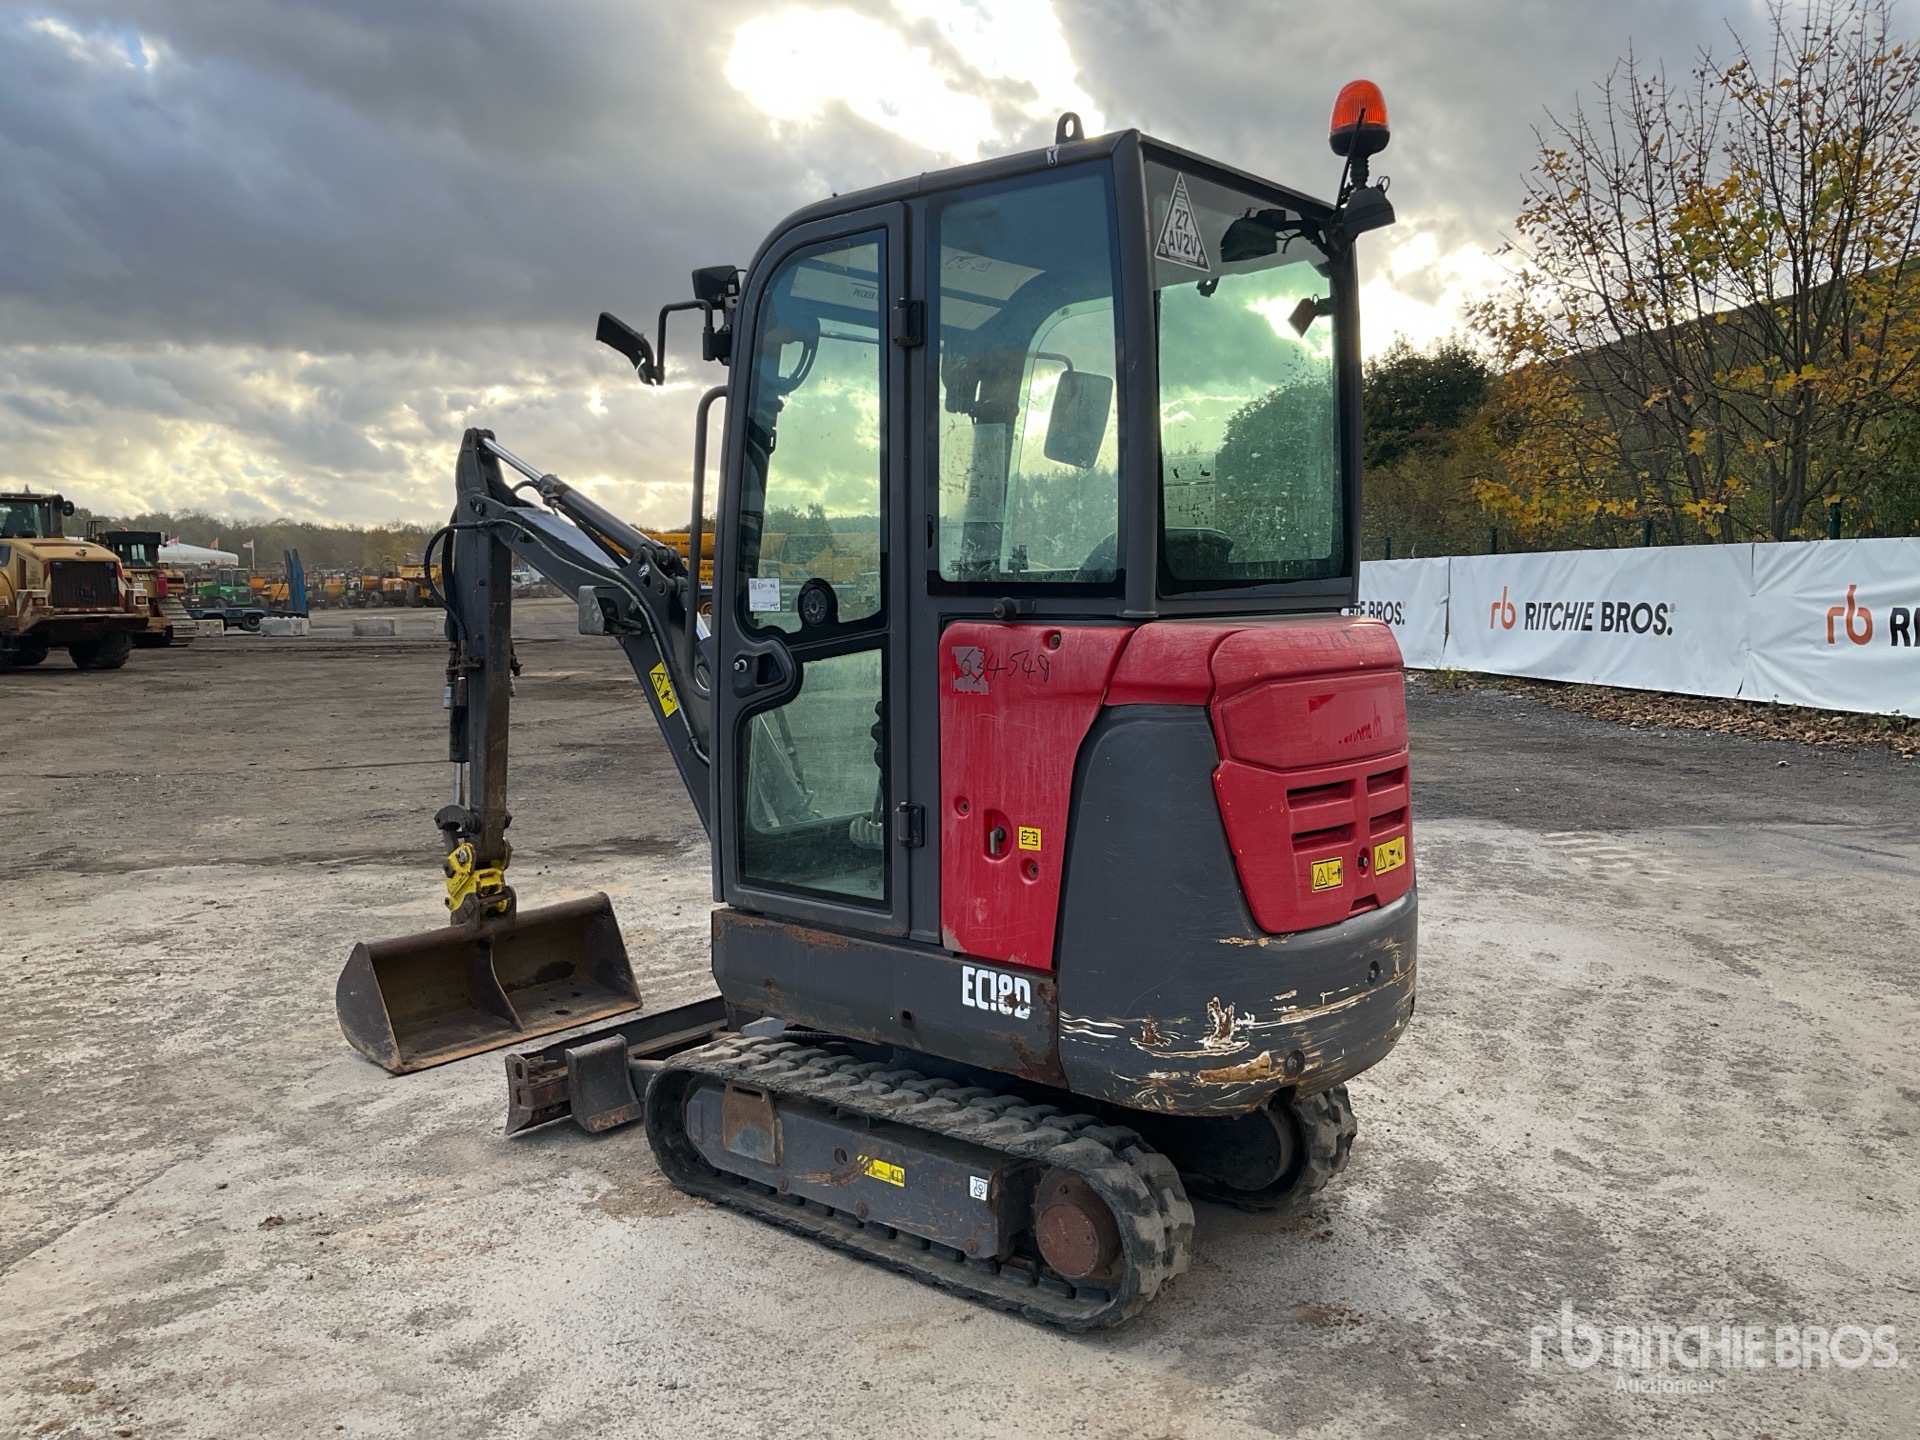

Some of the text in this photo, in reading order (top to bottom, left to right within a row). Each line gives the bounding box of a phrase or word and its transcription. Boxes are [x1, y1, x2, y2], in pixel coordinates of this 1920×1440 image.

[1175, 208, 1189, 231] 27
[1168, 229, 1197, 257] AV2V
[1524, 601, 1594, 632] RITCHIE
